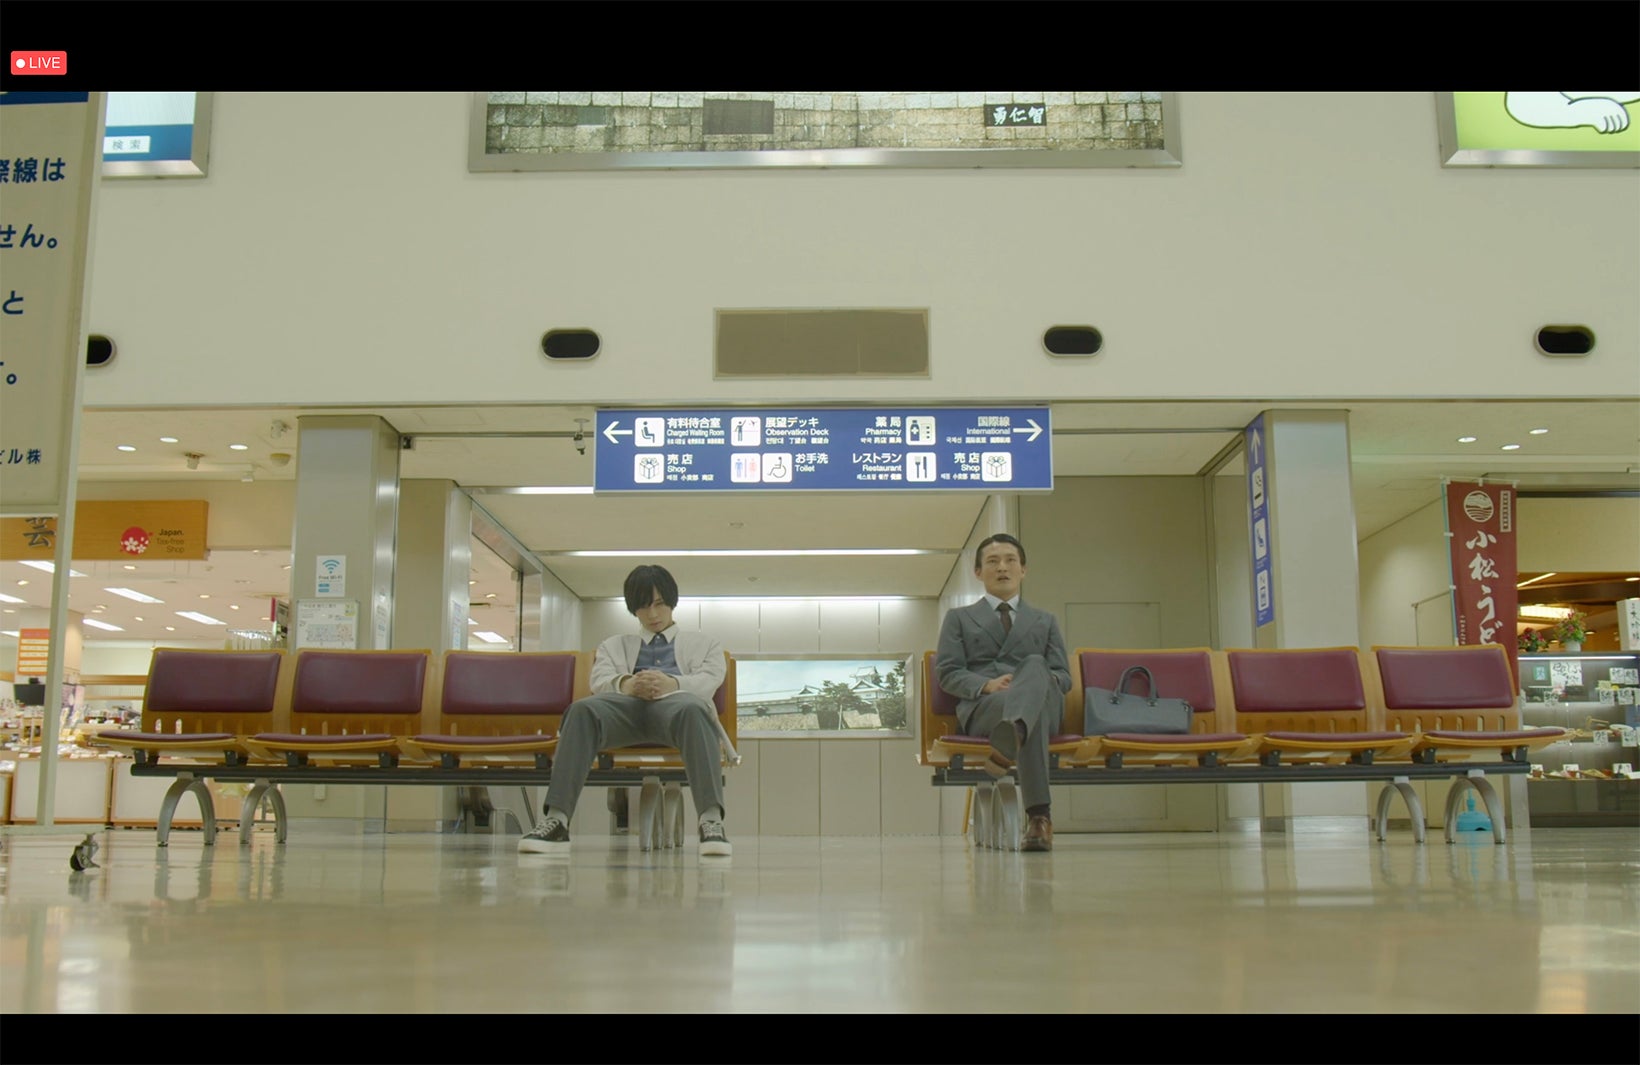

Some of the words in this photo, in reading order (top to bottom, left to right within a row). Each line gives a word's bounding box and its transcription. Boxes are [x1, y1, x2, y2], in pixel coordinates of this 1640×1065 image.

[992, 106, 1045, 126] 勇仁智
[2, 290, 24, 315] と
[666, 416, 722, 429] 有料待合室
[765, 416, 820, 428] 展望デッキ
[875, 415, 902, 428] 薬局
[977, 415, 1011, 427] 国際線
[666, 429, 689, 438] Charged
[765, 428, 809, 436] Observation
[810, 428, 830, 436] Deck
[865, 427, 902, 437] Pharmacy
[966, 427, 1011, 435] International
[667, 453, 693, 465] 売店
[795, 452, 829, 464] お手洗
[852, 453, 902, 464] レストラン
[953, 452, 980, 464] 売店
[667, 465, 687, 474] Shop
[795, 464, 815, 472] Toilet
[862, 464, 902, 472] Restaurant
[961, 463, 980, 473] Shop
[159, 528, 184, 537] Japan.
[166, 545, 185, 554] Shop
